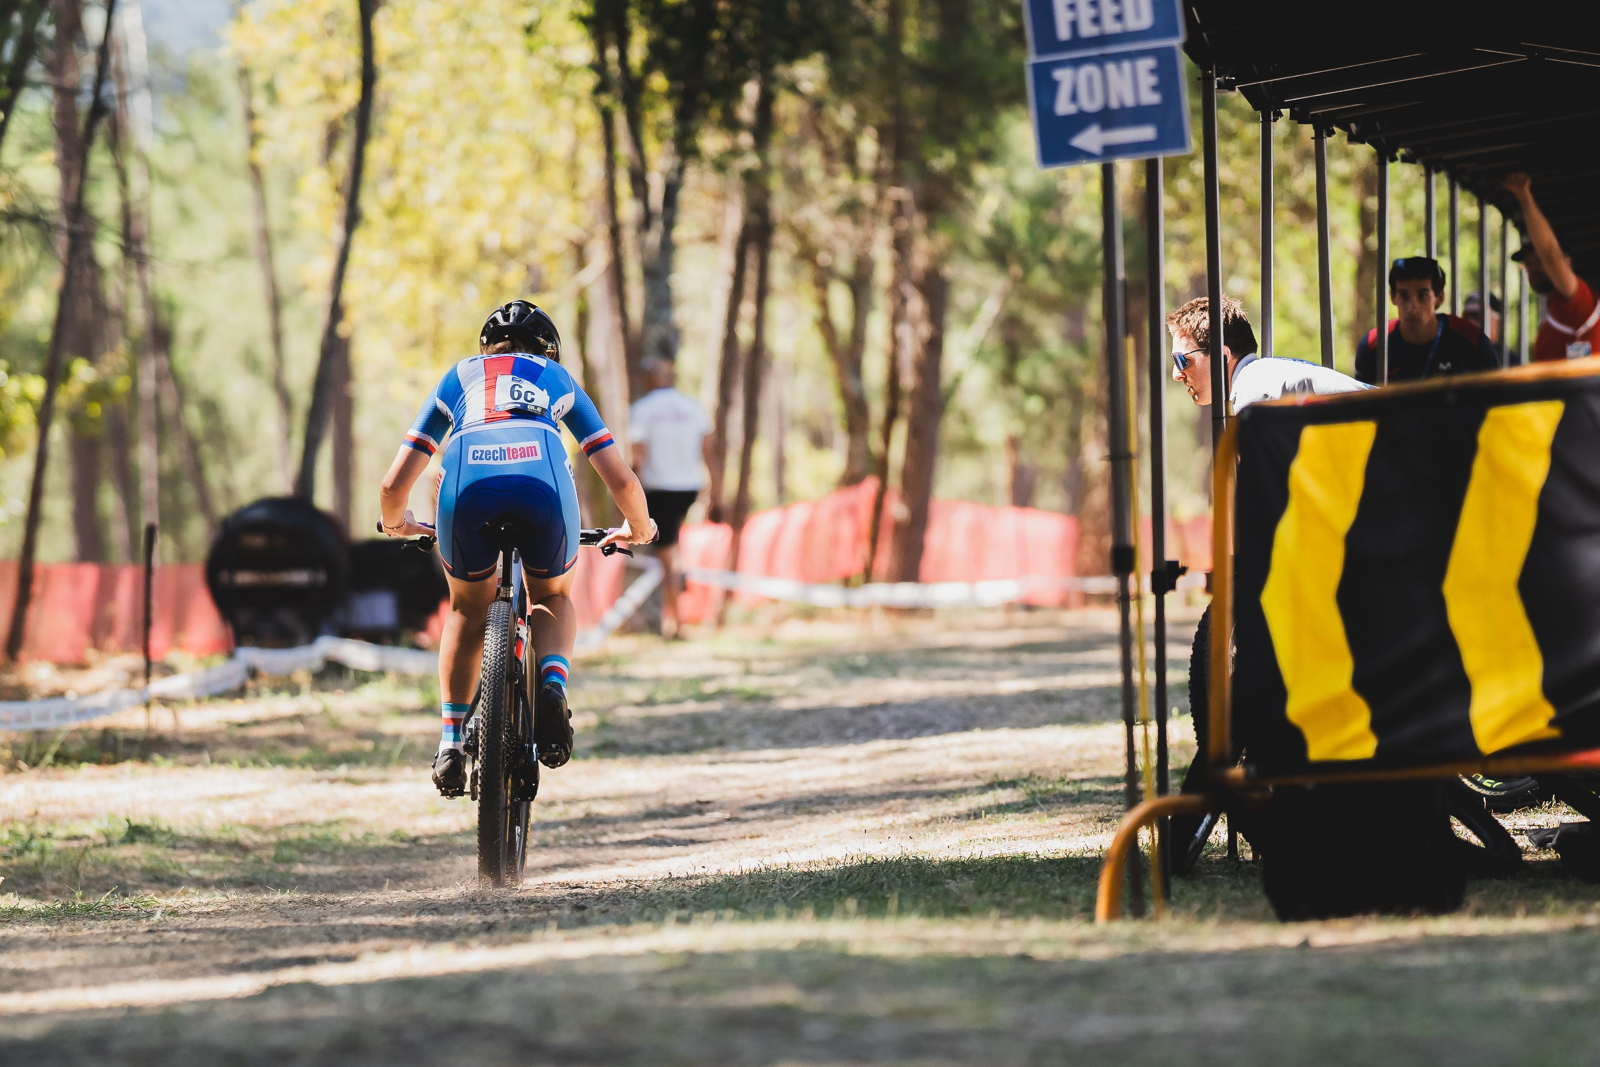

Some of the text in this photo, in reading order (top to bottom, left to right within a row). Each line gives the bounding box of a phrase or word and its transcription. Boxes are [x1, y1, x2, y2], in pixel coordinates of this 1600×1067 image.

[1053, 0, 1154, 42] FEED
[1052, 56, 1162, 116] ZONE
[510, 384, 536, 403] 6c
[472, 445, 538, 461] czechteam
